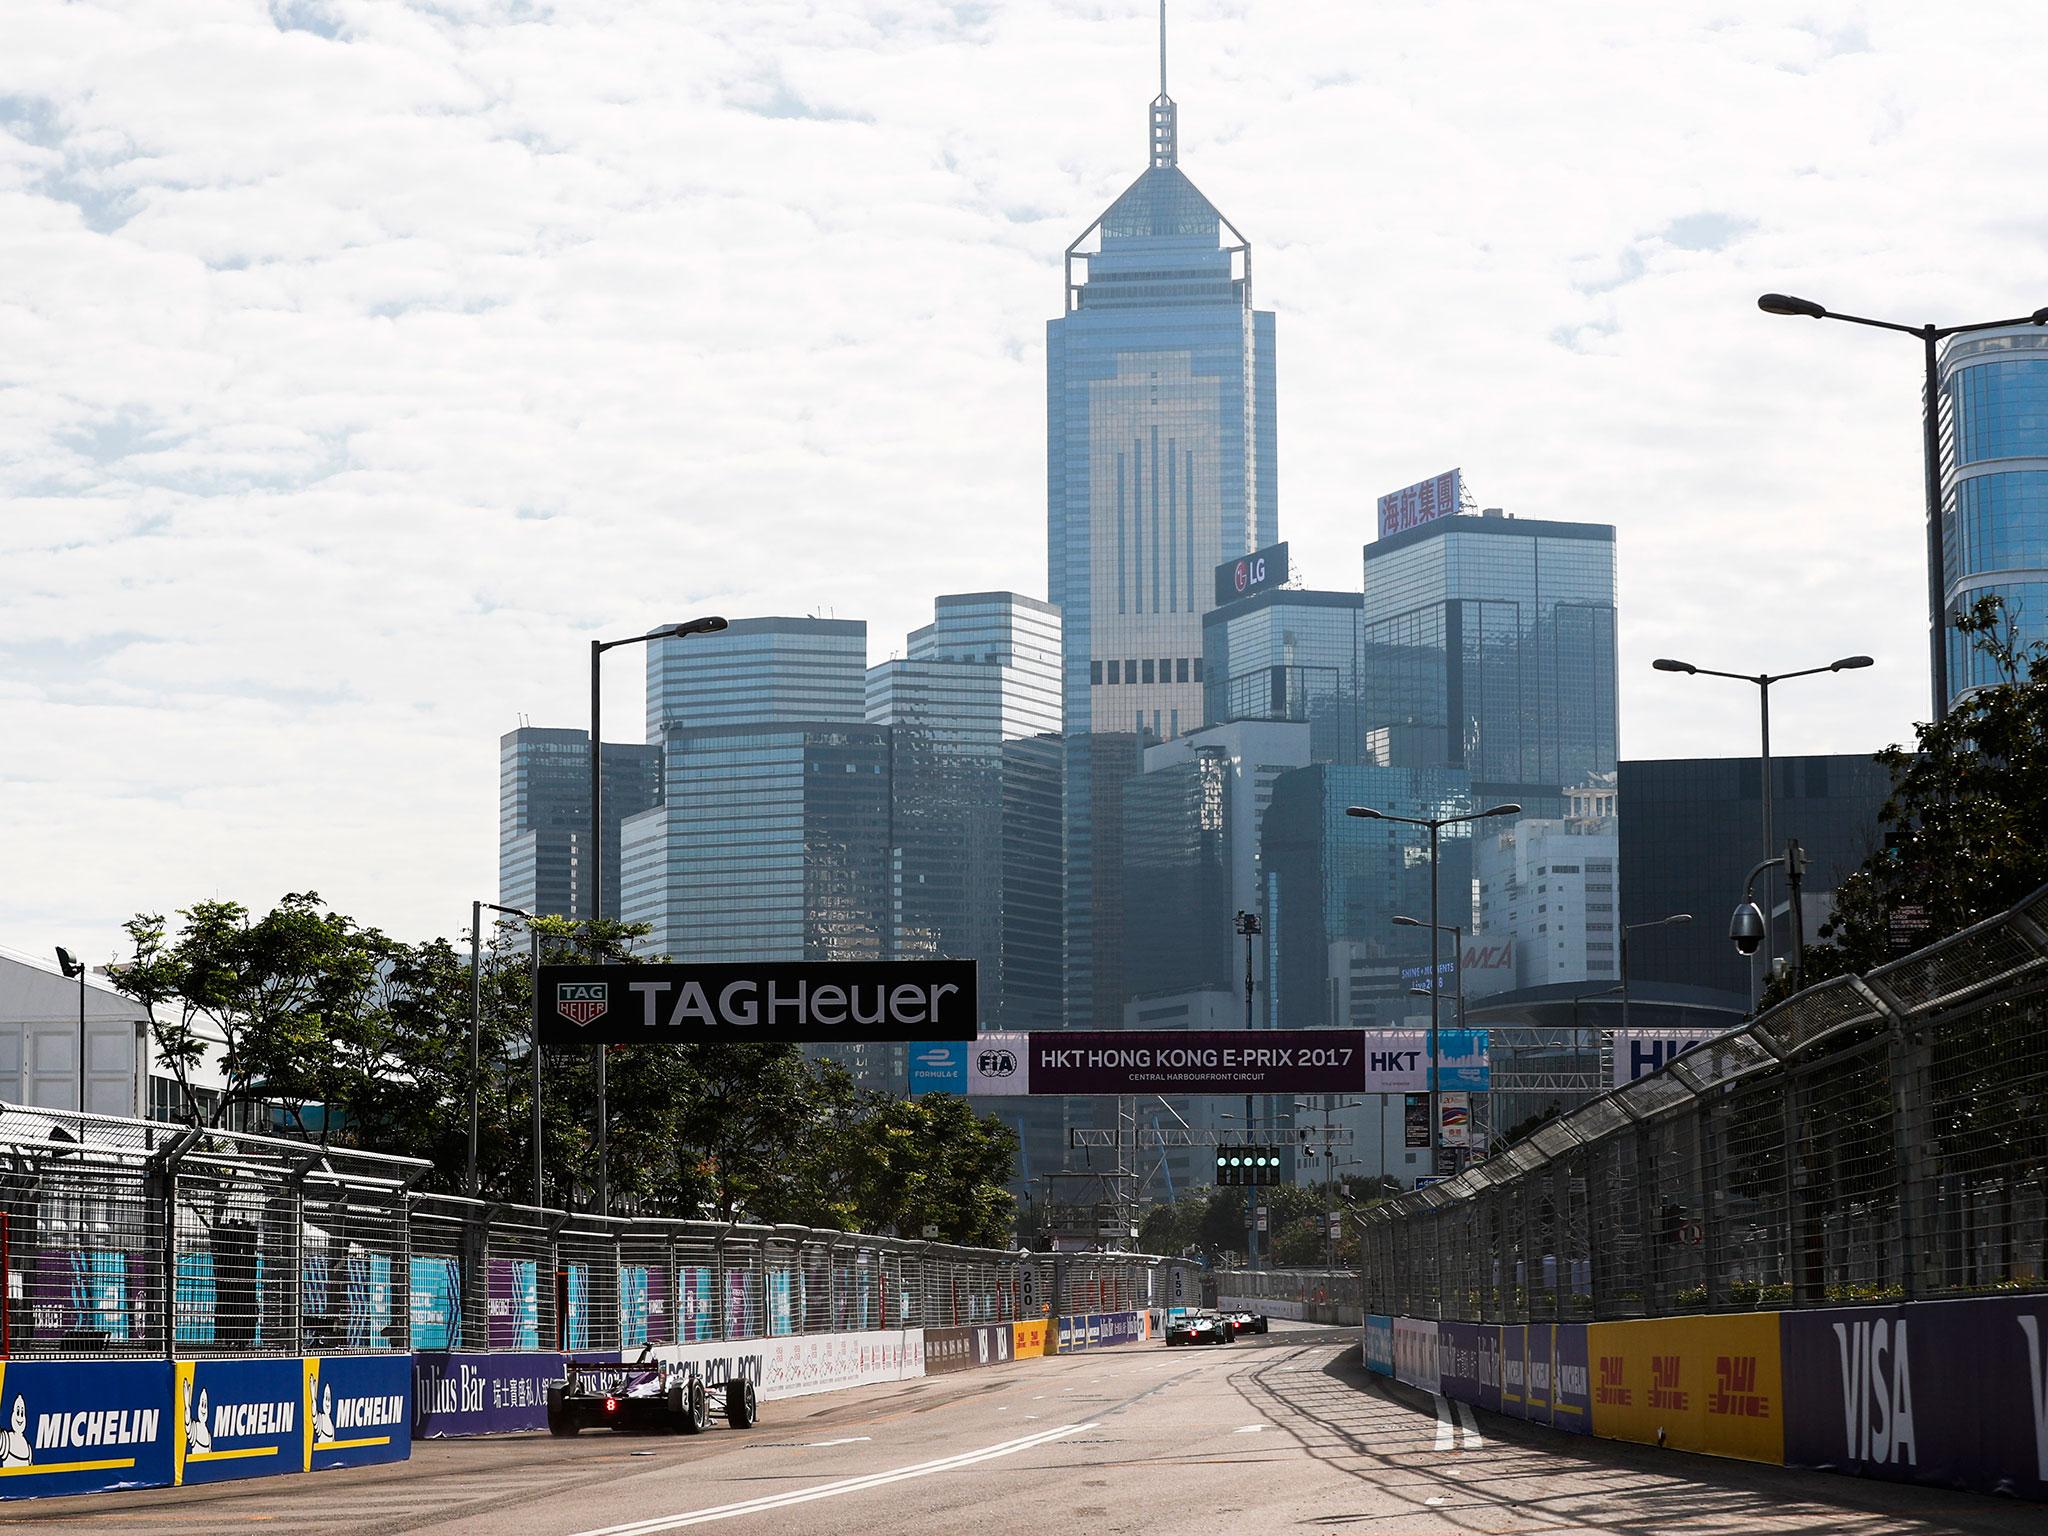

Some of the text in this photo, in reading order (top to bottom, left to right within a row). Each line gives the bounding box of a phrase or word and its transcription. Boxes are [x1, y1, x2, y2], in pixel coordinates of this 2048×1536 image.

[1382, 472, 1455, 535] 海航集團
[1250, 558, 1265, 585] LG
[561, 986, 603, 999] TAG
[560, 1002, 605, 1023] HEUER
[1041, 1048, 1353, 1068] HKT HONG KONG E-PRIX 2017
[1370, 1051, 1422, 1072] HKT
[1128, 1072, 1265, 1081] CENTRAL HARBOURFRONT CIRCUIT
[1023, 1271, 1033, 1306] 200
[1174, 1271, 1182, 1297] 150
[416, 1364, 486, 1426] Julius Bär
[1832, 1318, 1917, 1466] VISA
[213, 1401, 295, 1437] MICHELIN
[336, 1395, 404, 1428] MICHELIN
[36, 1408, 160, 1449] MICHELIN
